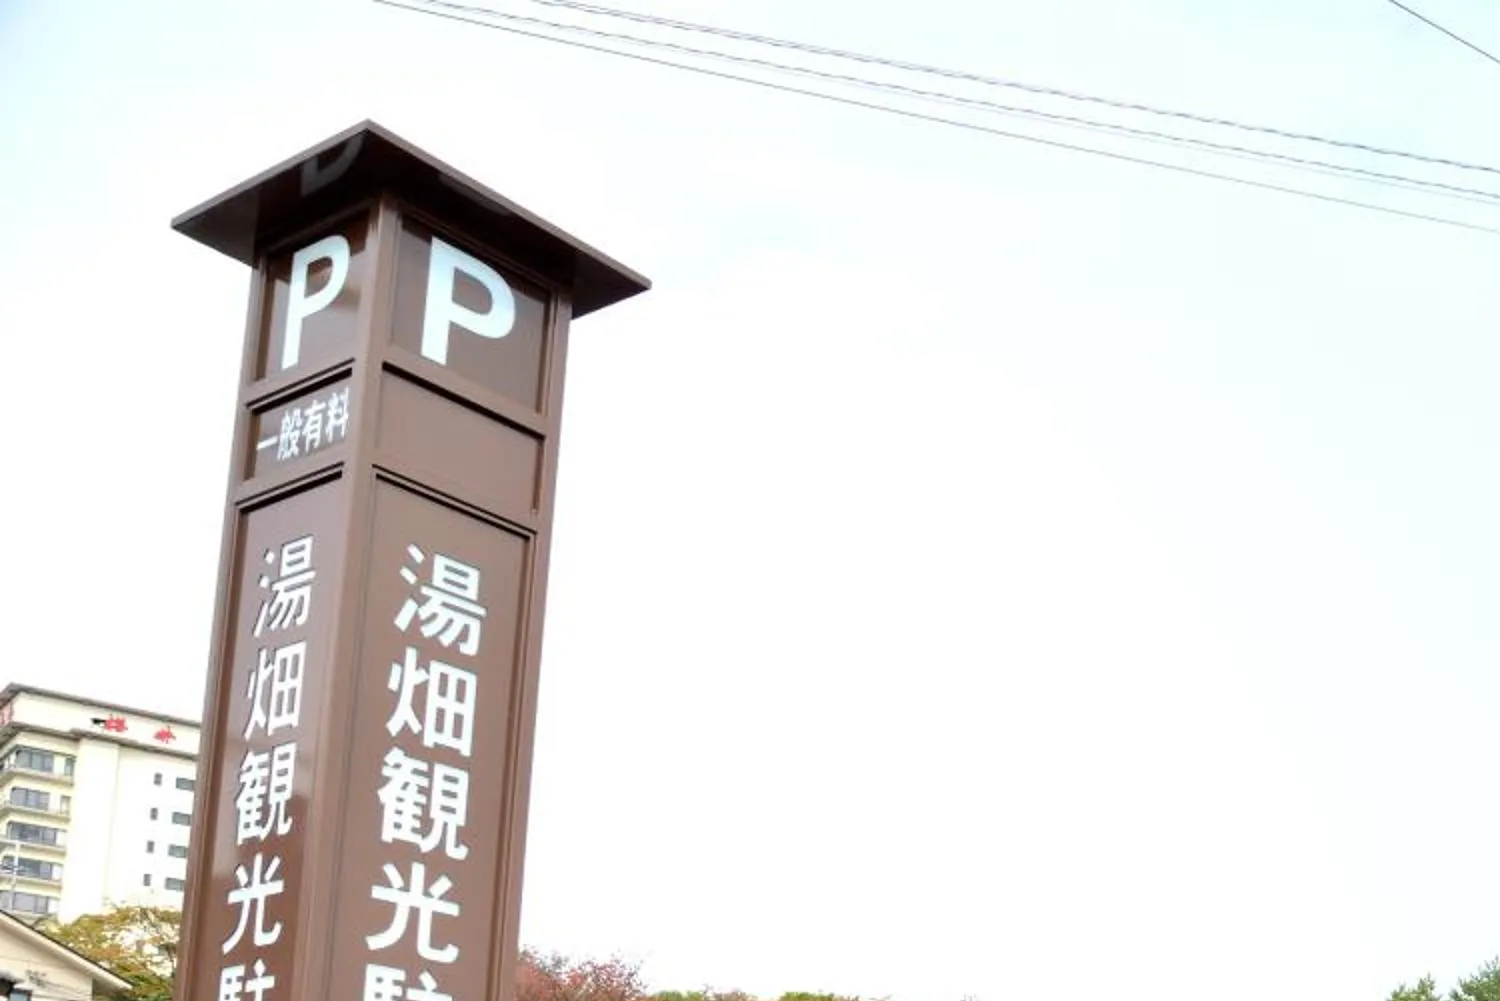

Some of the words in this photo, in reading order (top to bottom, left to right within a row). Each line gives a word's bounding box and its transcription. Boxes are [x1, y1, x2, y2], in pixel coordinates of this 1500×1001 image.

[280, 235, 350, 370] P
[420, 235, 516, 366] P
[256, 388, 350, 460] 一般有料
